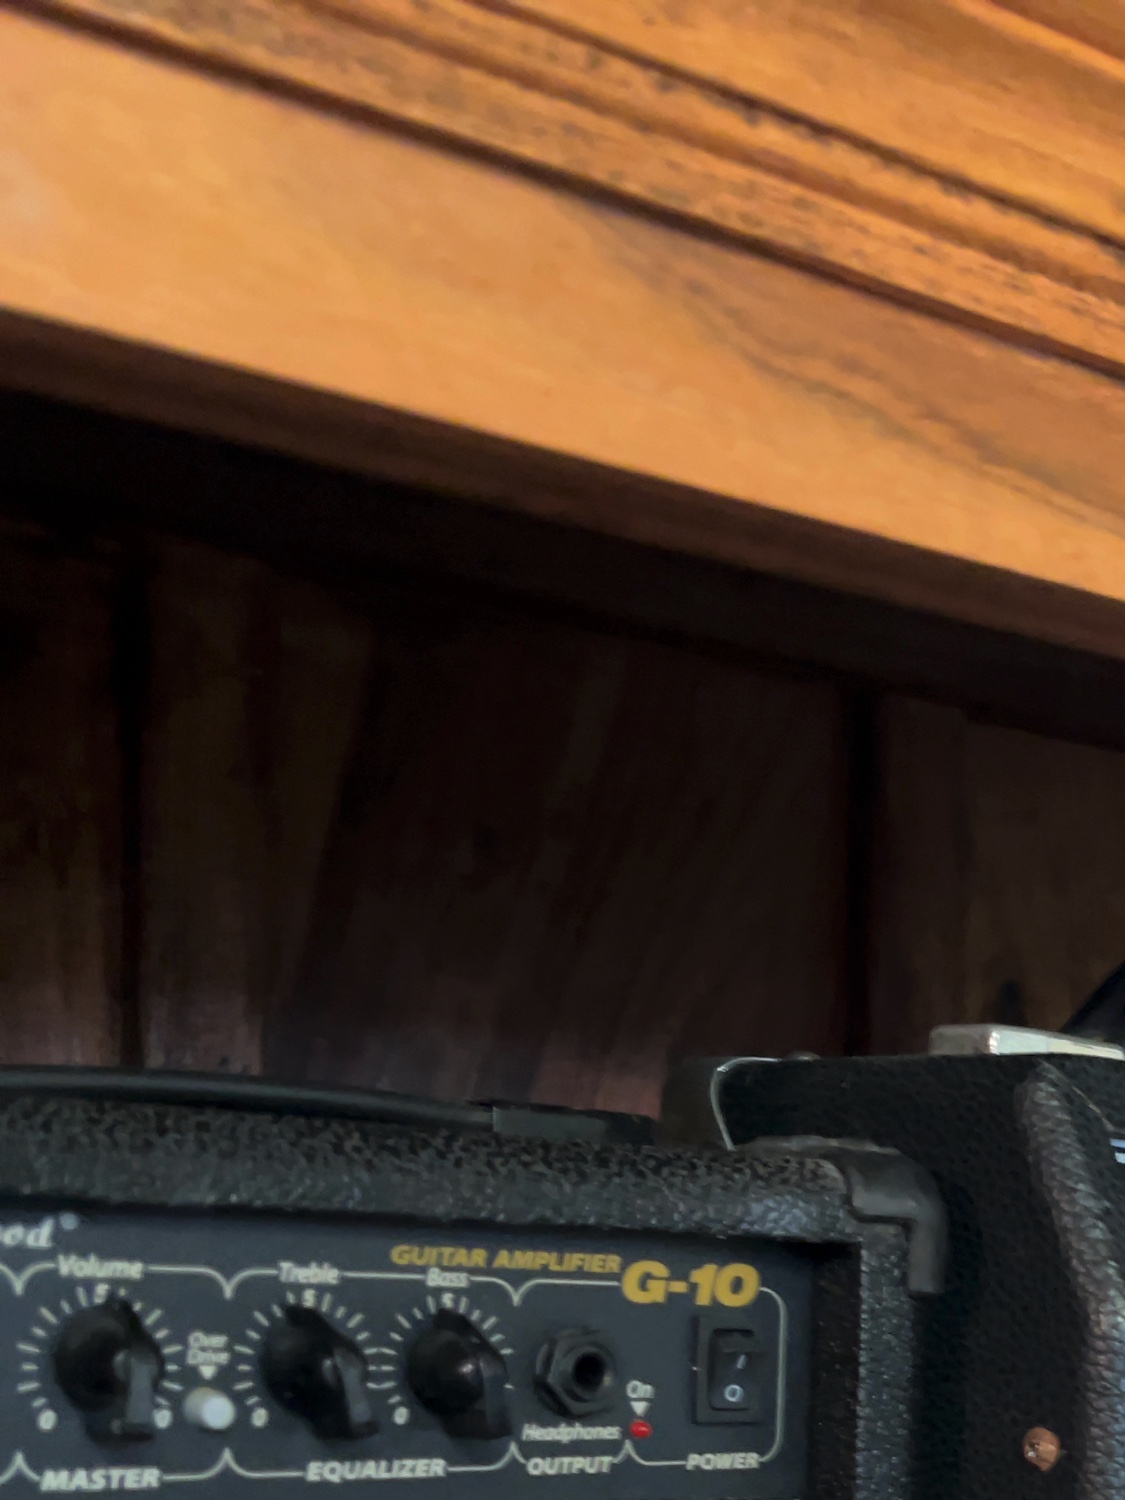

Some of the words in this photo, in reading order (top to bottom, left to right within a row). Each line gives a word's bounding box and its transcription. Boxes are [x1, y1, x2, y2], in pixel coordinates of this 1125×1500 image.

[58, 1254, 145, 1280] Volume
[390, 1244, 488, 1268] GUITAR
[492, 1249, 622, 1273] AMPLIFIER
[278, 1260, 340, 1285] Treble
[426, 1266, 469, 1288] Bass
[621, 1259, 761, 1308] G-10
[626, 1380, 655, 1399] On
[521, 1423, 623, 1444] Headphones
[306, 1458, 447, 1483] EQUALIZER
[527, 1456, 614, 1476] OUTPUT
[686, 1452, 760, 1471] POWER
[40, 1468, 162, 1492] MASTER
